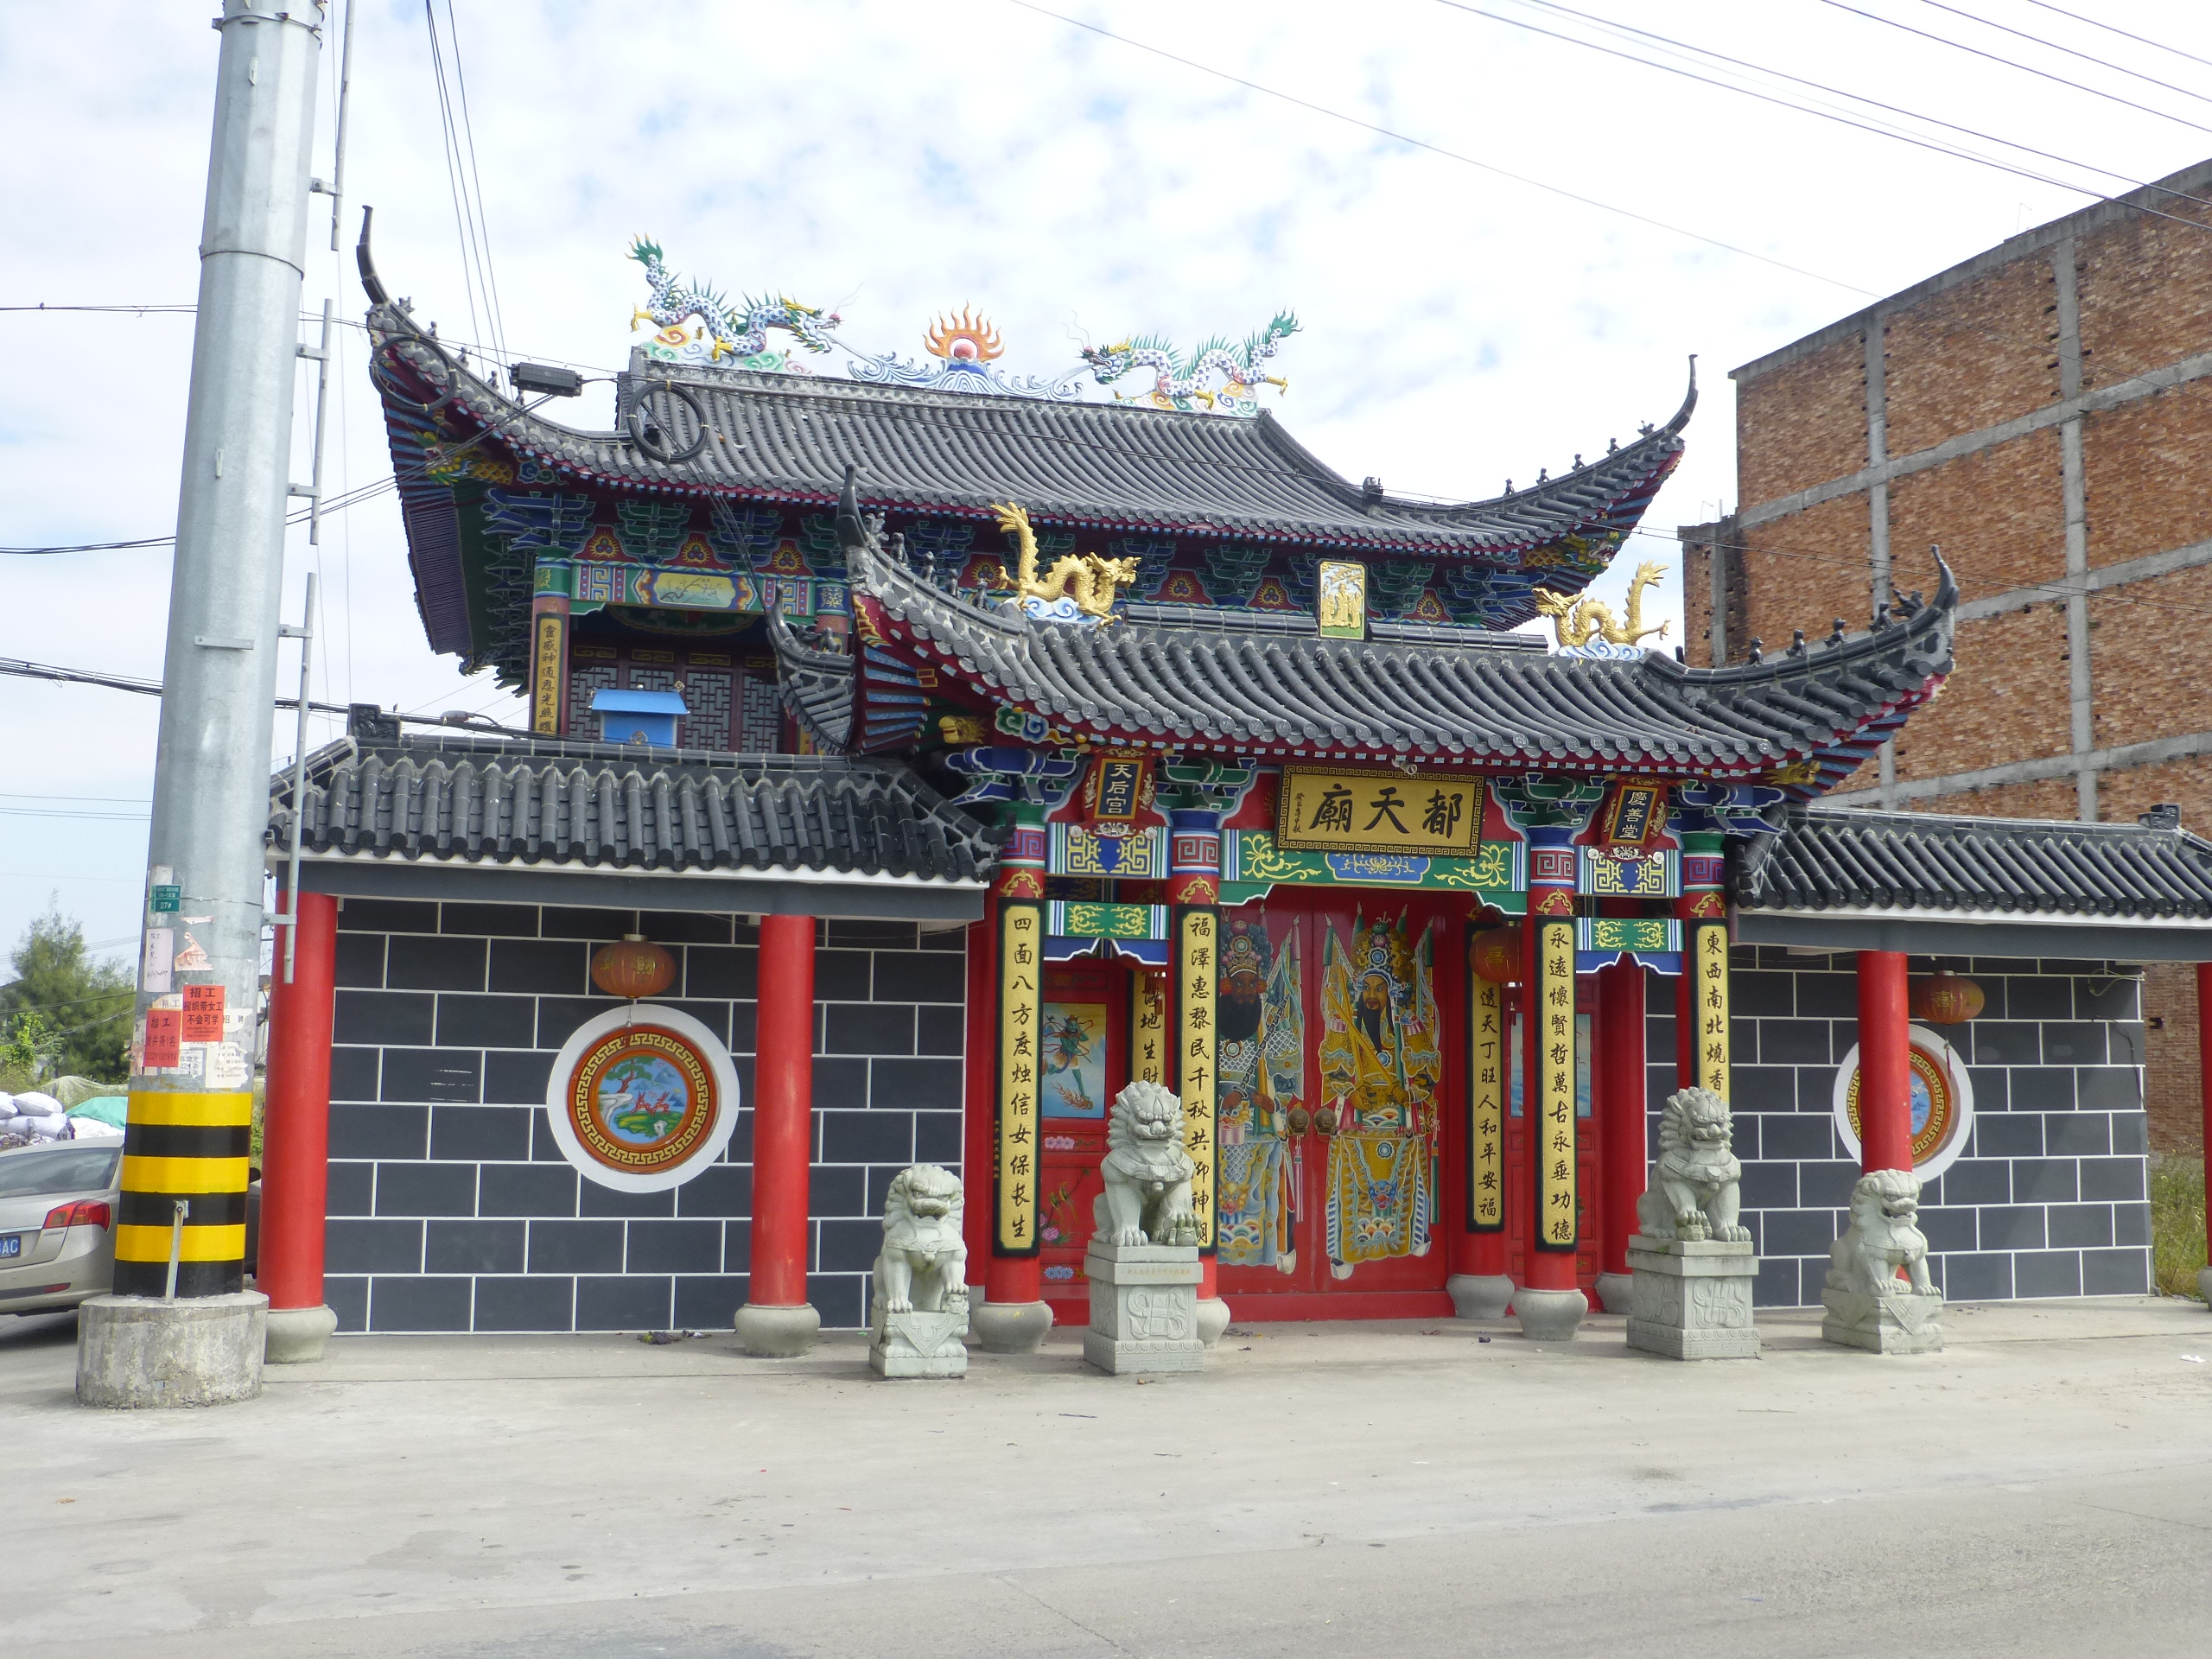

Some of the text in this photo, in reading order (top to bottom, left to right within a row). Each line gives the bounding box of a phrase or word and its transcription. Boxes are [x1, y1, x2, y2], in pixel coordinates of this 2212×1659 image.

[1106, 764, 1132, 814] 天后宫
[1619, 791, 1648, 839] 慶善堂
[190, 988, 216, 998] 招工
[188, 1014, 219, 1025] 不会可学
[0, 1240, 18, 1254] AC
